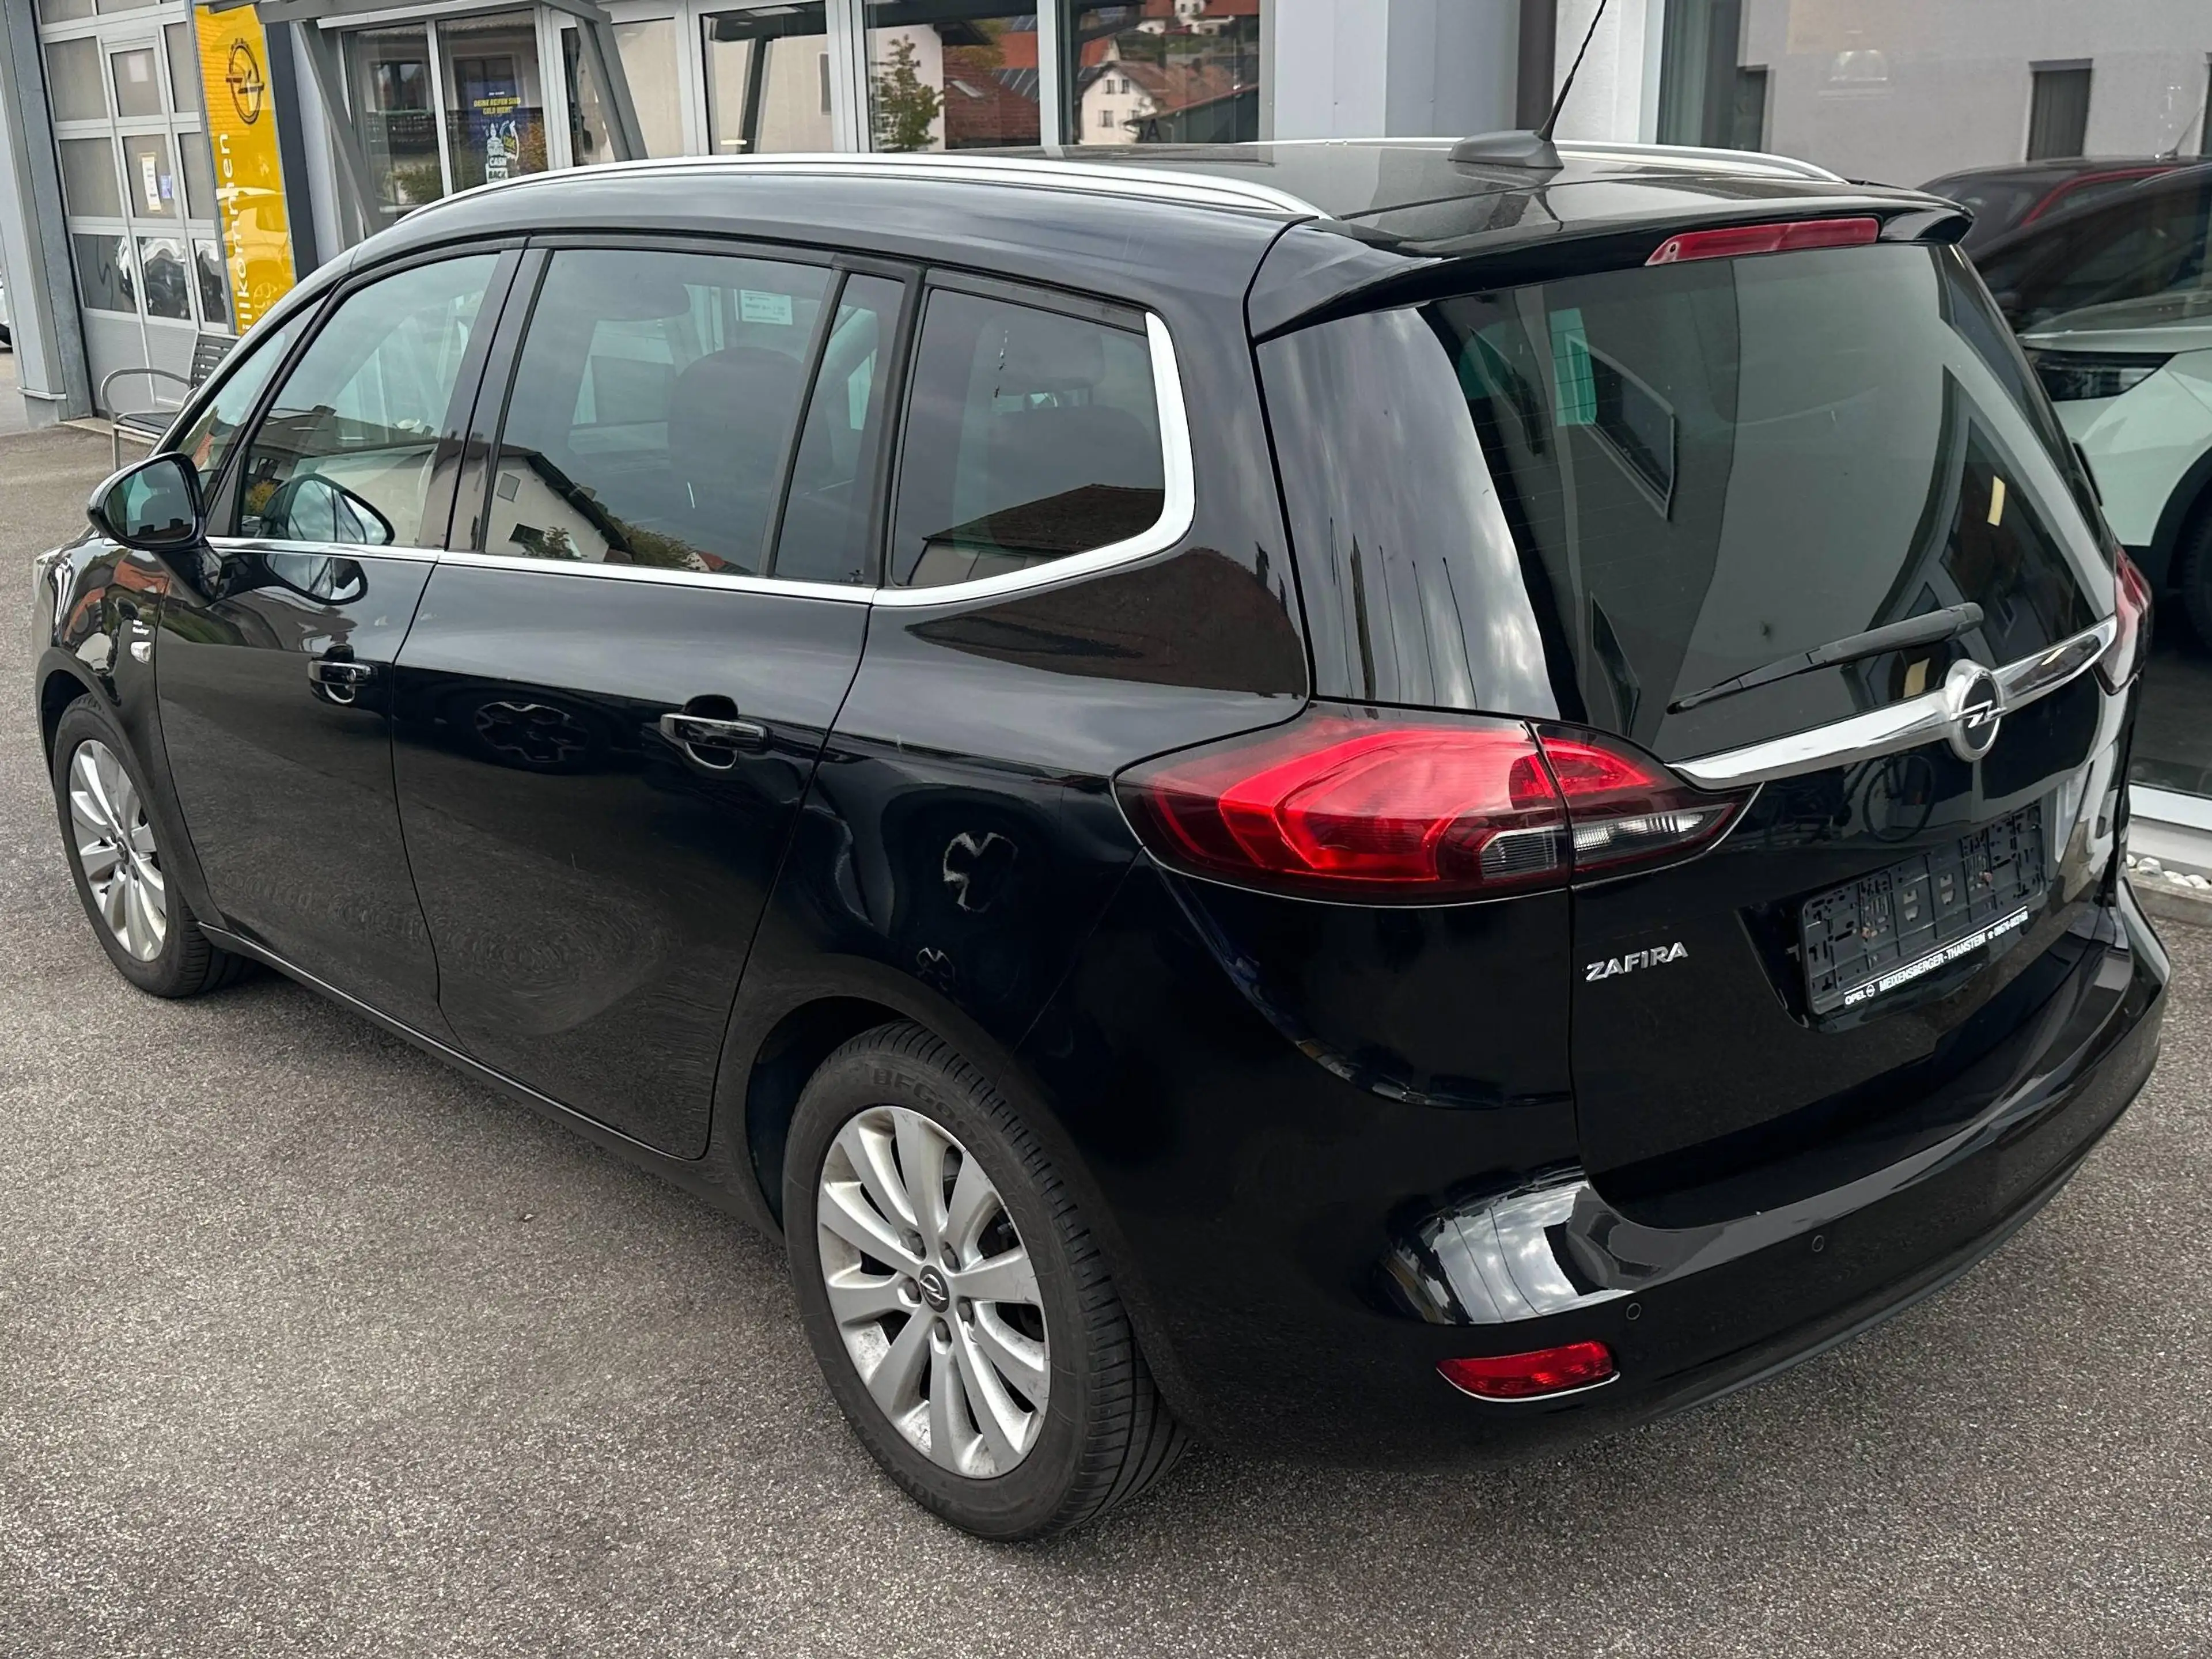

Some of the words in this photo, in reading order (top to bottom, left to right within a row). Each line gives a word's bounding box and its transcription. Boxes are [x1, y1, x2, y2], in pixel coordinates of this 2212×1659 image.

[219, 133, 253, 330] illkommen
[1585, 941, 1690, 983] ZAFIRA
[1844, 990, 1867, 1005] OPEL
